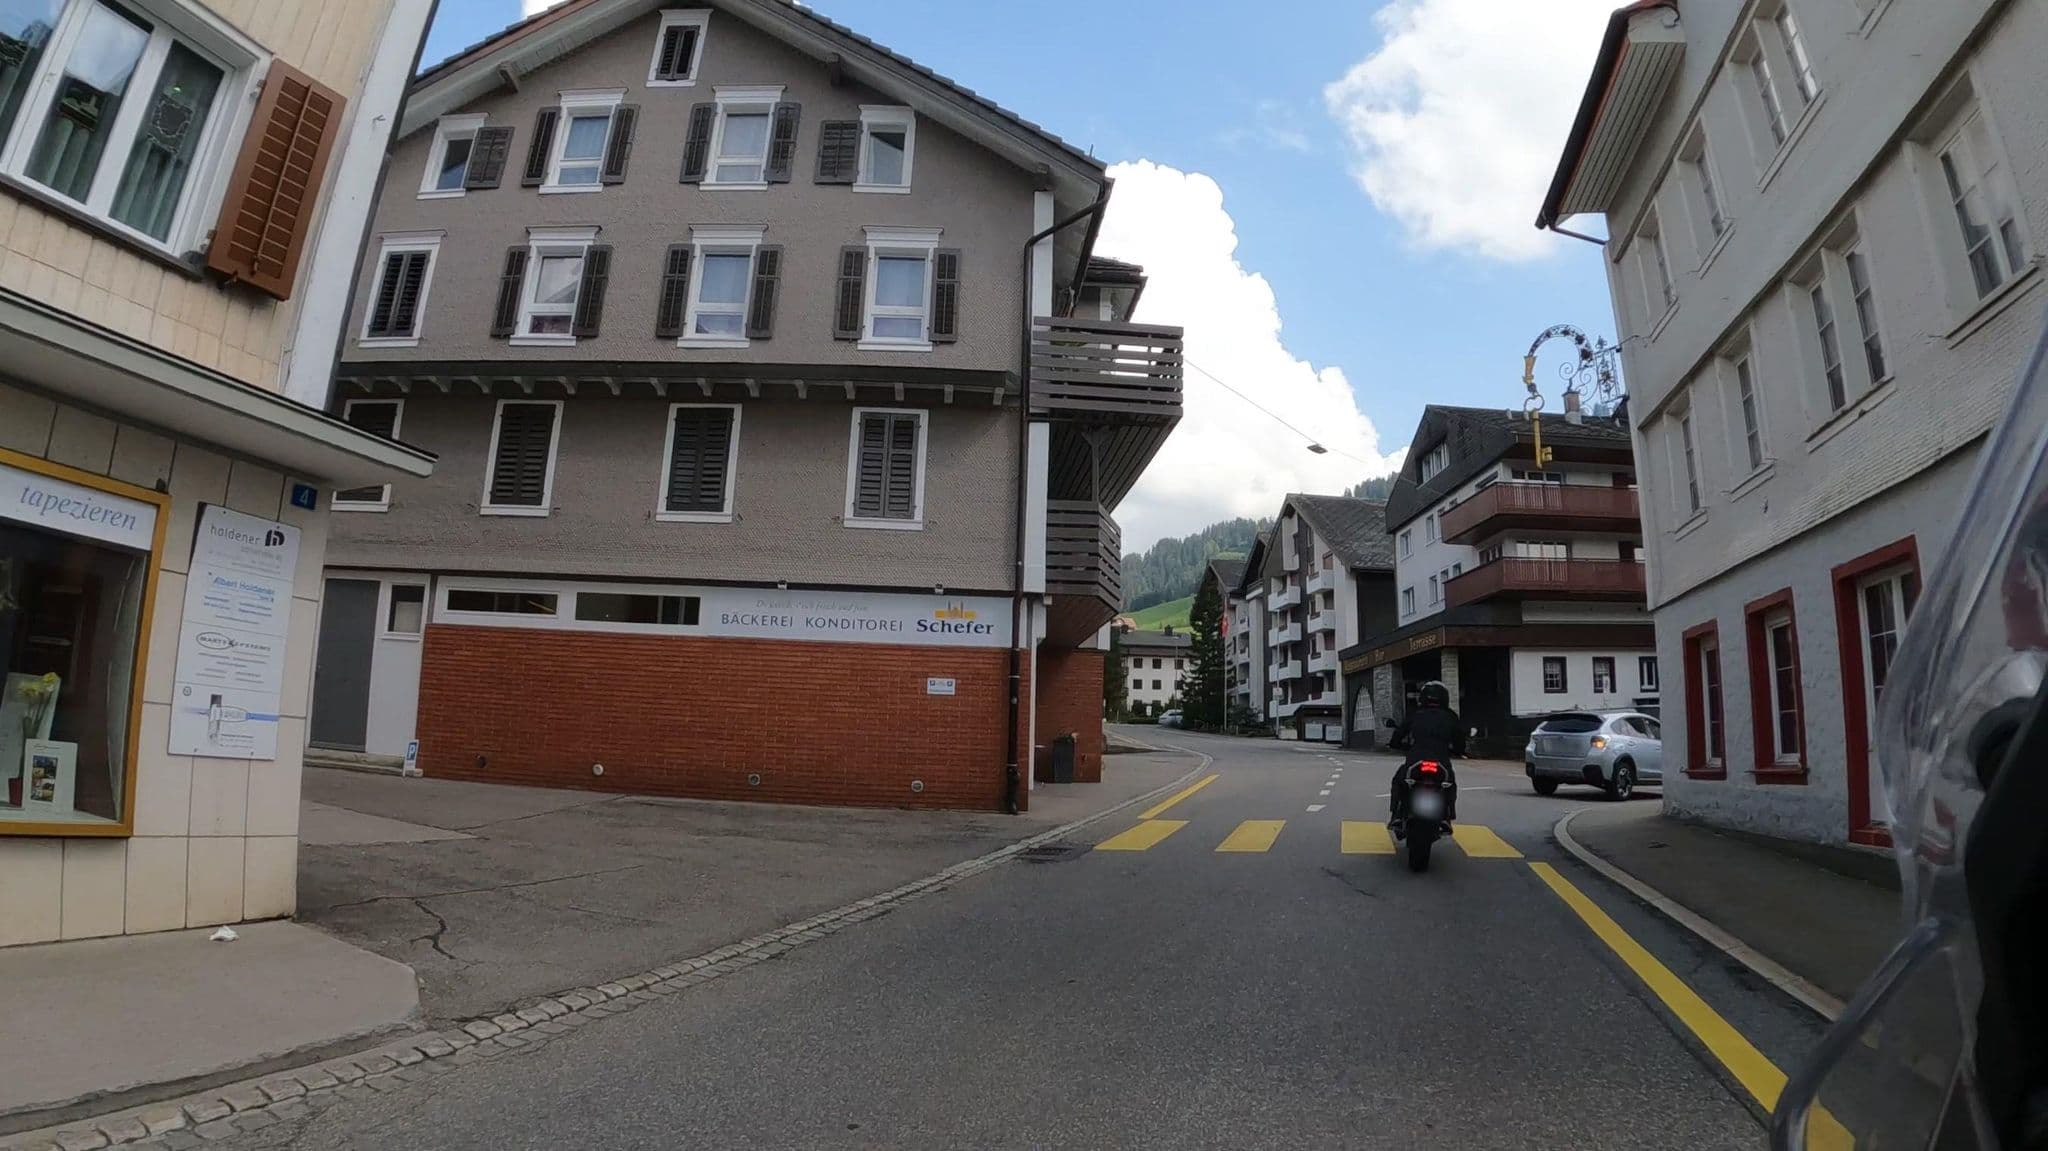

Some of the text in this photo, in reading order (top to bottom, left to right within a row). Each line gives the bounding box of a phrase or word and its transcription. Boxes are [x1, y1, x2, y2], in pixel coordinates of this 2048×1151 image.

[299, 490, 310, 506] 4
[19, 484, 138, 532] tapezieren
[805, 616, 904, 632] KONDITOREI
[916, 618, 994, 635] Schefer
